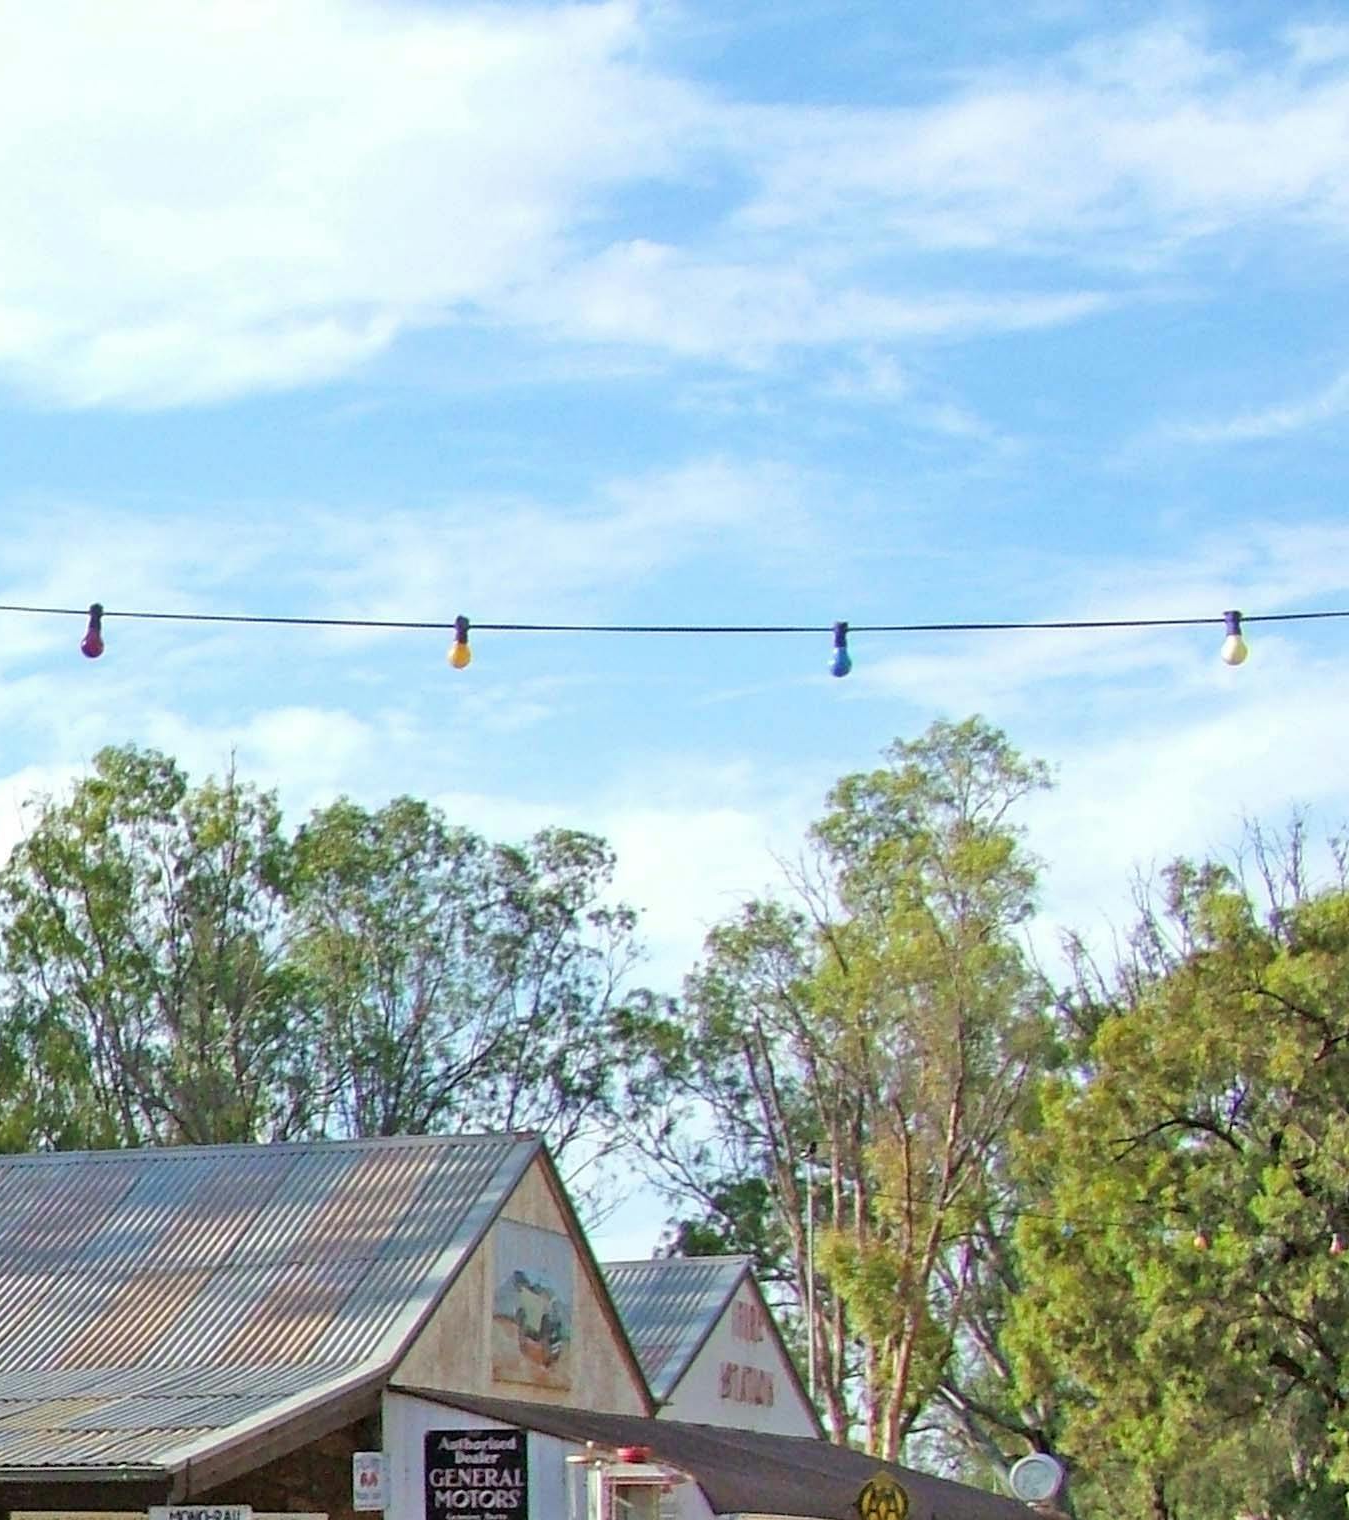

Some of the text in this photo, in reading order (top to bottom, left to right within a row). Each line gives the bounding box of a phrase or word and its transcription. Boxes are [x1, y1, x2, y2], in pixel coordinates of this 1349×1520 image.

[454, 1451, 501, 1464] Dealer
[428, 1467, 526, 1488] GENERAL
[433, 1489, 522, 1509] MOTORS
